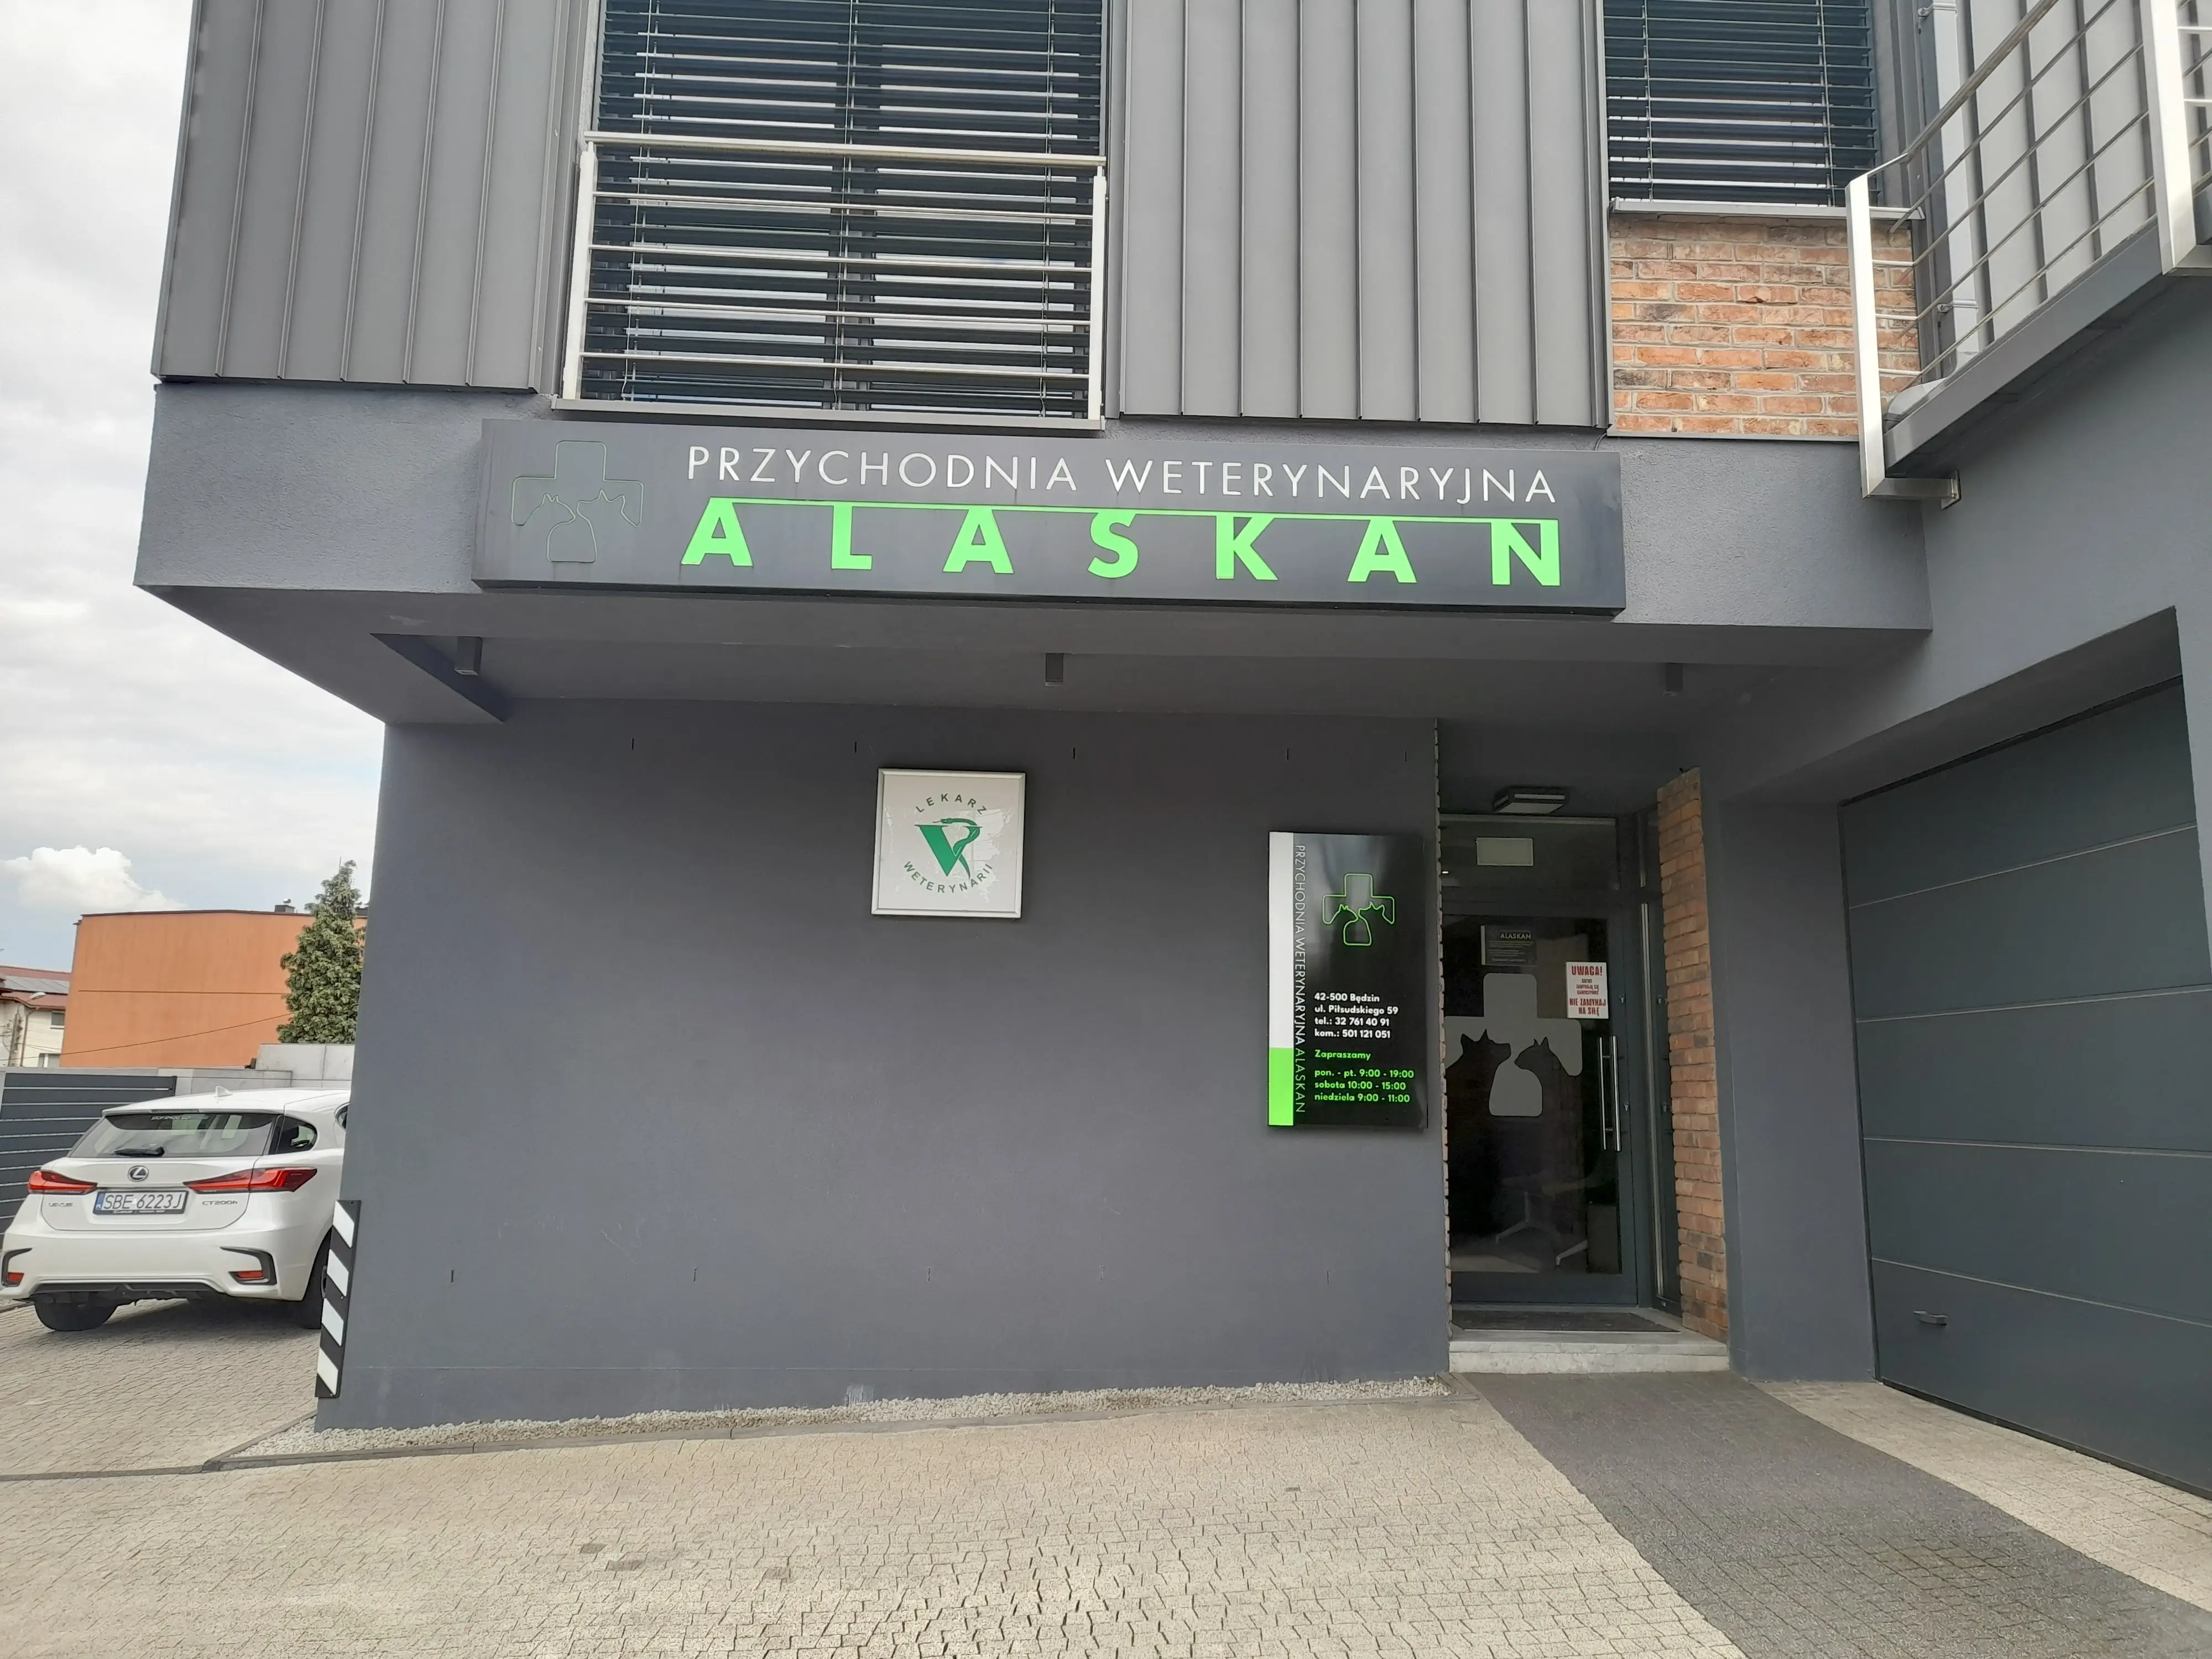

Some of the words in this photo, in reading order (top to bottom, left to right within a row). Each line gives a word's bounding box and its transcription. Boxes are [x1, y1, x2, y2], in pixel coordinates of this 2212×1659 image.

[687, 445, 1077, 492] PRZYCHODNIA
[1104, 458, 1557, 505] WETERYNARYJNA
[680, 497, 1561, 587] ALASKAN
[916, 793, 987, 815] LEKARZ
[904, 861, 993, 894] WETERYNARII
[1294, 844, 1306, 934] PRZYCHODNIA
[1571, 966, 1603, 976] UWAGA!
[1294, 935, 1306, 1045] WETERYNARYJNA
[1314, 993, 1348, 1001] 42-500
[1350, 993, 1380, 1004] Będzin
[1314, 1004, 1326, 1013] ul.
[1328, 1005, 1385, 1016] Piłsudskiego
[1387, 1006, 1399, 1015] 59
[1314, 1016, 1333, 1025] tel.:
[1334, 1017, 1347, 1025] 32
[1349, 1018, 1364, 1026] 761
[1365, 1018, 1378, 1026] 40
[1380, 1018, 1390, 1027] 91
[1314, 1028, 1340, 1037] kom.:
[1342, 1029, 1358, 1038] 501
[1359, 1030, 1373, 1038] 121
[1375, 1030, 1391, 1039] 051
[1314, 1049, 1371, 1061] Zapraszamy
[1295, 1047, 1306, 1113] ALASKAN
[1344, 1070, 1357, 1079] pt.
[1359, 1069, 1381, 1077] 9:00
[1389, 1070, 1415, 1078] 19:00
[1314, 1080, 1345, 1089] sobota
[1347, 1081, 1373, 1089] 10:00
[1381, 1082, 1407, 1091] 15:00
[1314, 1092, 1355, 1101] niedziela
[1357, 1093, 1379, 1102] 9:00
[1387, 1094, 1411, 1103] 11:00
[103, 1194, 133, 1209] SBE
[137, 1194, 182, 1209] 6223J
